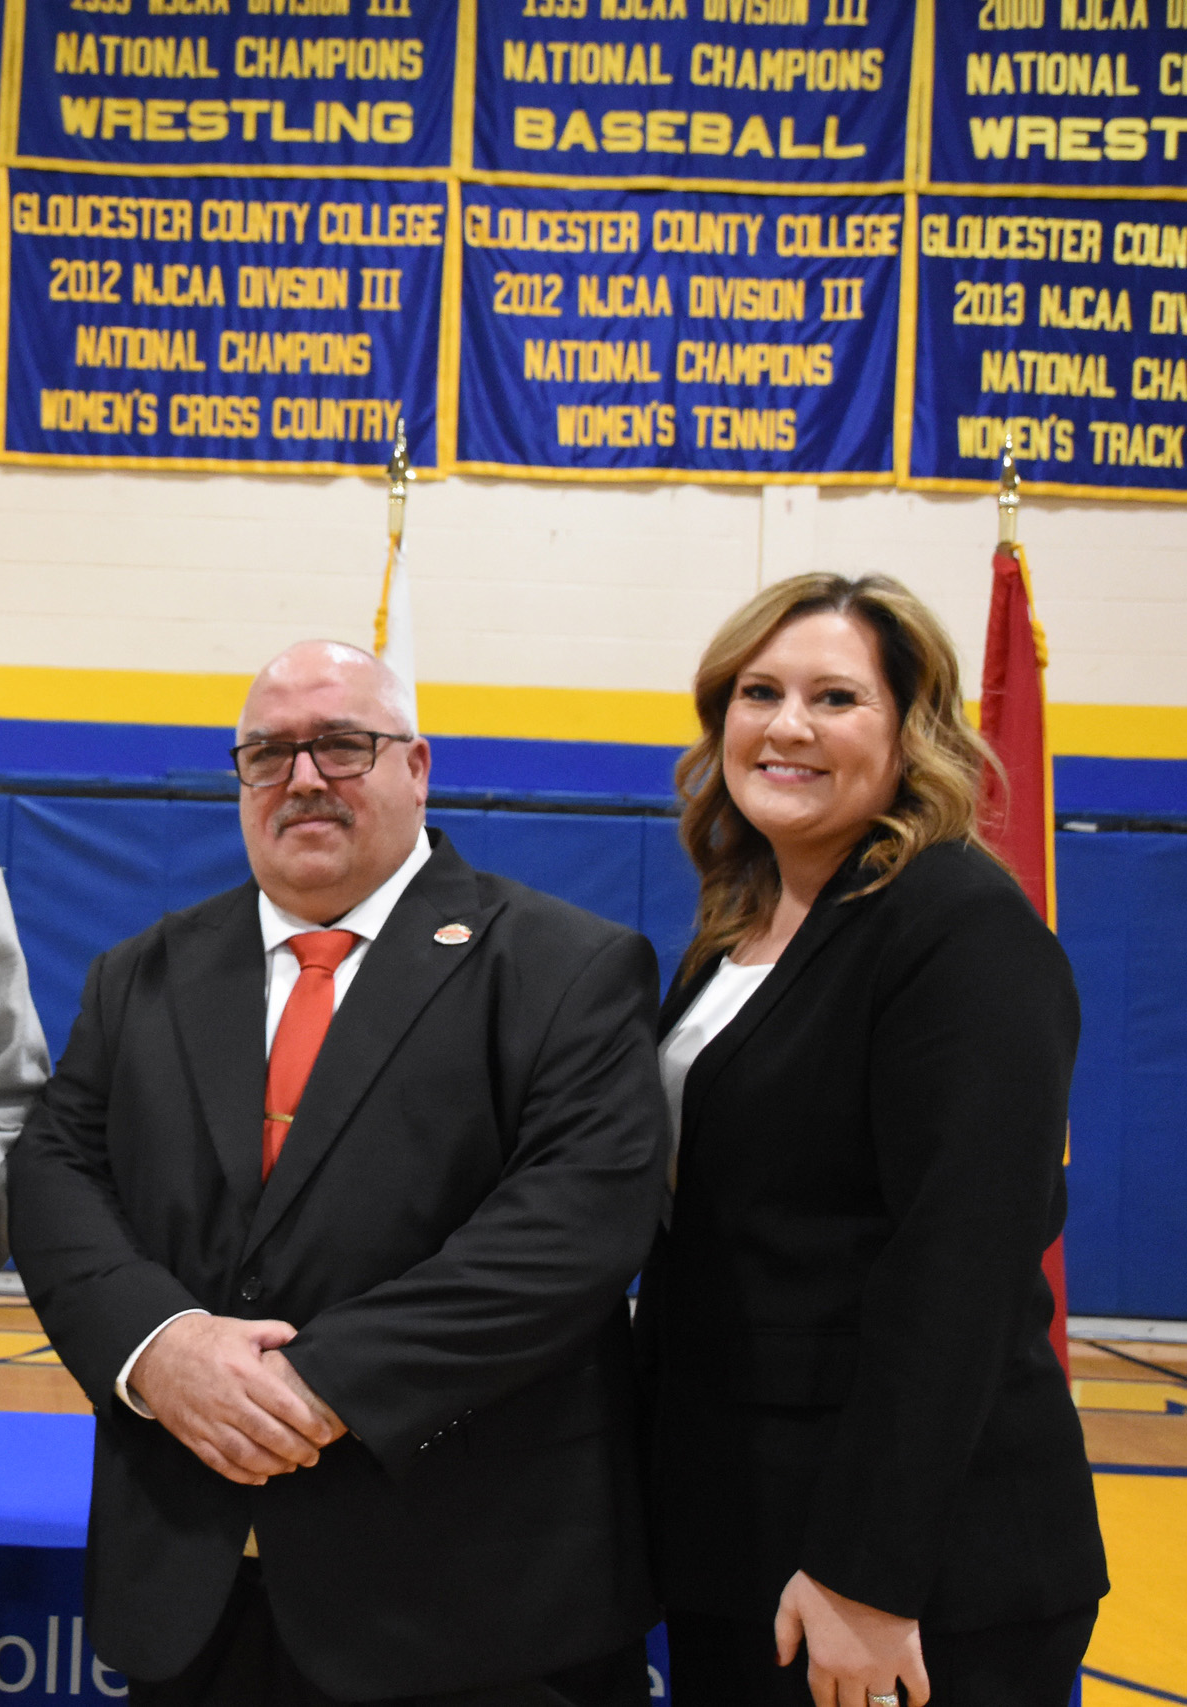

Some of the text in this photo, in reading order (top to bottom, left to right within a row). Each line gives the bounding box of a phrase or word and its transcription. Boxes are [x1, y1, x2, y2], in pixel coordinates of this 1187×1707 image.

[55, 33, 423, 80] NATIONAL CHAMPIONS
[504, 40, 884, 91] NATIONAL CHAMPIONS
[967, 52, 1139, 96] NATIONAL
[61, 96, 413, 143] WRESTLING
[514, 107, 866, 159] BASEBALL
[13, 189, 442, 245] GLOUCESTER COUNTY COLLEGE
[465, 206, 901, 257] GLOUCESTER COUNTY COLLEGE
[922, 212, 1102, 263] GLOUCESTER
[50, 258, 402, 310] 2012 NJCAA DIVISION III
[493, 271, 864, 321] 2012 NJCAA DIVISION III
[953, 281, 1025, 326] 2013
[1040, 285, 1132, 331] NJCAA
[76, 325, 371, 375] NATIONAL CHAMPIONS
[525, 340, 833, 386] NATIONAL CHAMPIONS
[981, 350, 1116, 398] NATIONAL
[41, 389, 406, 442] WOMEN'S CROSS COUNTRY
[558, 401, 796, 451] WOMEN'S TENNIS
[958, 414, 1185, 468] WOMEN'S TRACK
